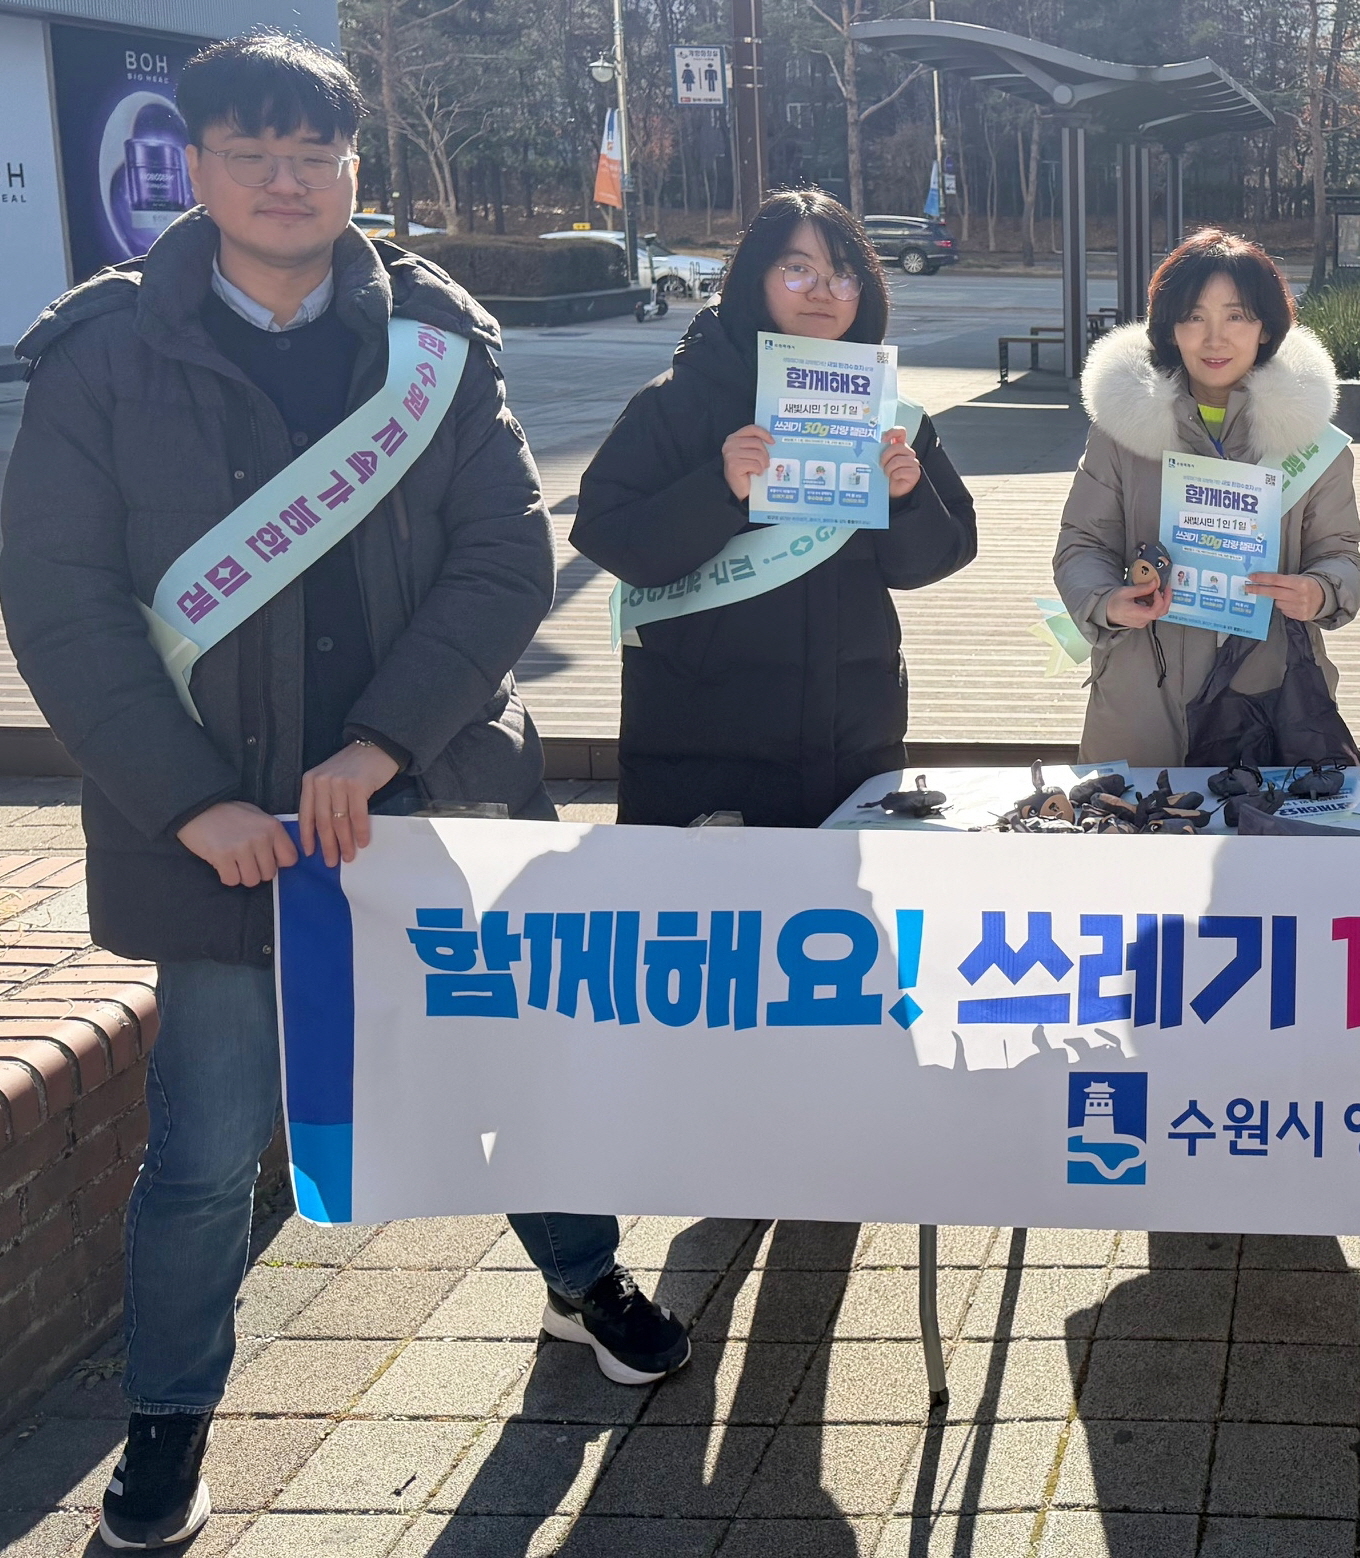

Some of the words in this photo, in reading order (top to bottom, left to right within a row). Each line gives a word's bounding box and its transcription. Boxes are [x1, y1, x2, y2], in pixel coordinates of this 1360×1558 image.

[125, 51, 168, 73] BOH
[402, 362, 437, 422] 수원
[786, 366, 871, 396] 함께해요
[784, 403, 821, 415] 새빛시민
[822, 403, 840, 415] 1인
[774, 421, 802, 432] 쓰레기
[801, 421, 830, 437] 30g
[830, 425, 849, 436] 감량
[245, 416, 409, 563] 지속가능한
[1185, 484, 1258, 514] 함께해요
[1183, 516, 1215, 527] 새빛시민
[1216, 518, 1231, 529] 1인
[1176, 531, 1198, 542] 쓰레기
[1199, 534, 1222, 550] 30g
[1222, 539, 1239, 550] 감량
[709, 555, 757, 585] 지구
[176, 554, 252, 625] 미래
[405, 908, 924, 1031] 함께해요!
[957, 911, 1297, 1030] 쓰레기
[1167, 1097, 1324, 1158] 수원시
